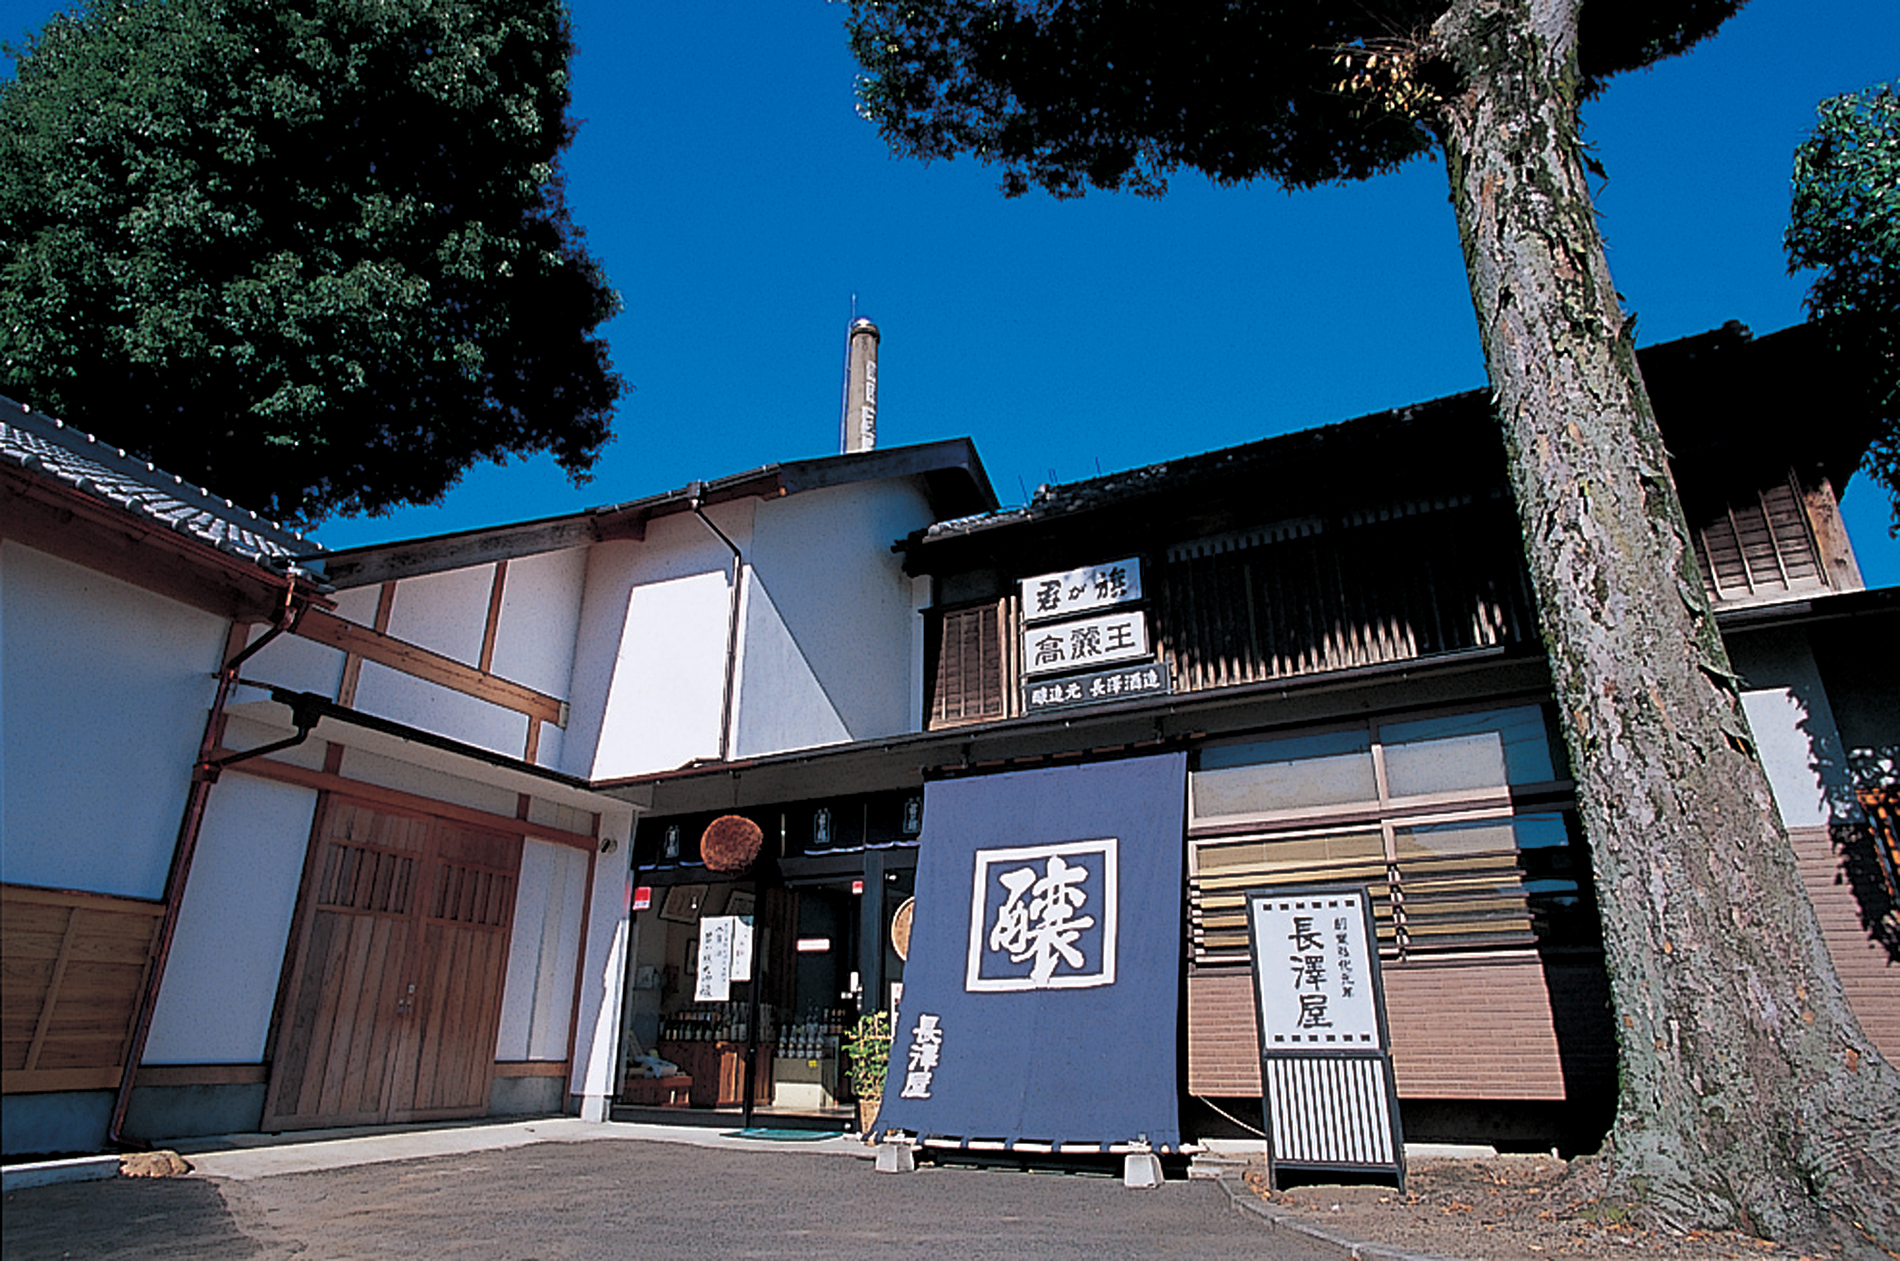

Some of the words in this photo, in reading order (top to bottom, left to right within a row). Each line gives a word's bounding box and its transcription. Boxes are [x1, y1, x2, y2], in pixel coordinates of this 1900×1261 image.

[1036, 566, 1127, 612] 君が旗
[1288, 916, 1333, 1029] 長澤屋
[900, 1014, 943, 1099] 長澤屋
